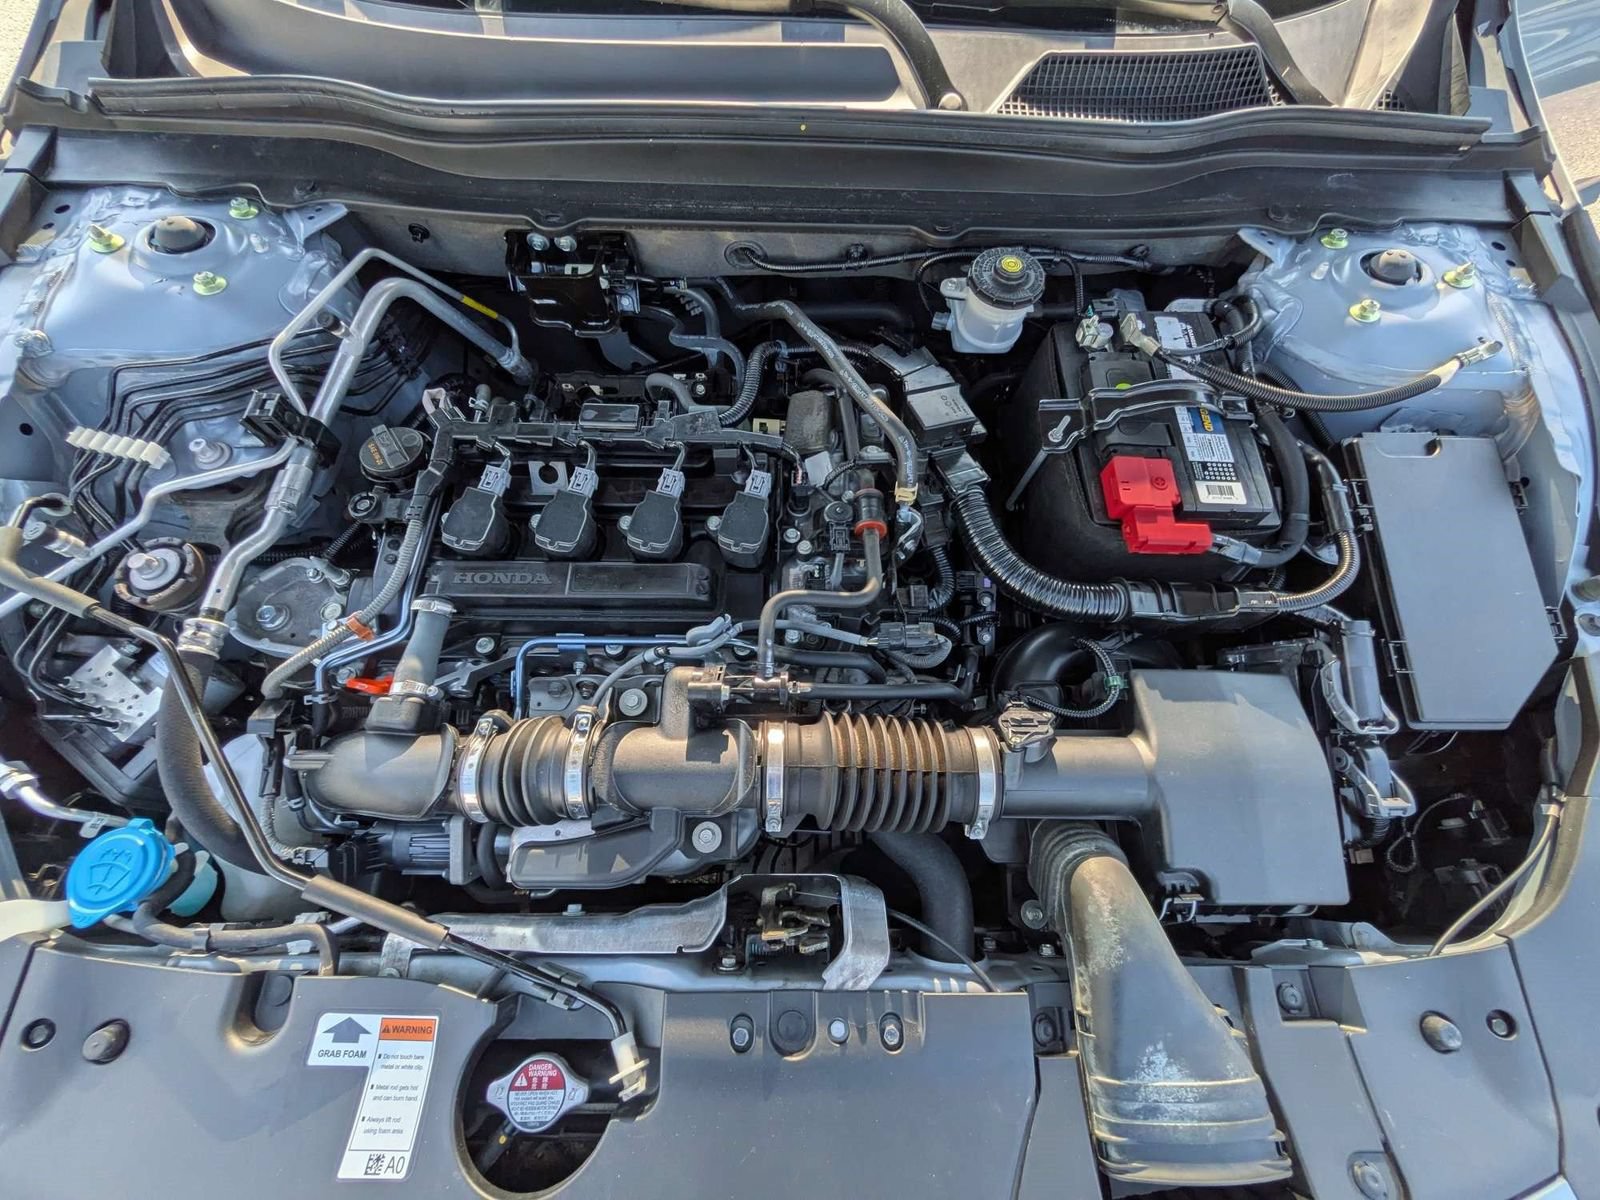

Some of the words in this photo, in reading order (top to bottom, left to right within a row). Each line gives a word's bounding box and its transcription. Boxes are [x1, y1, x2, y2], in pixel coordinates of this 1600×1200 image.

[453, 572, 552, 585] HONDA
[392, 1026, 432, 1034] WARNING
[318, 1049, 341, 1058] GRAB
[342, 1050, 367, 1059] FOAM
[366, 1116, 385, 1124] Always
[384, 1156, 406, 1174] A0
